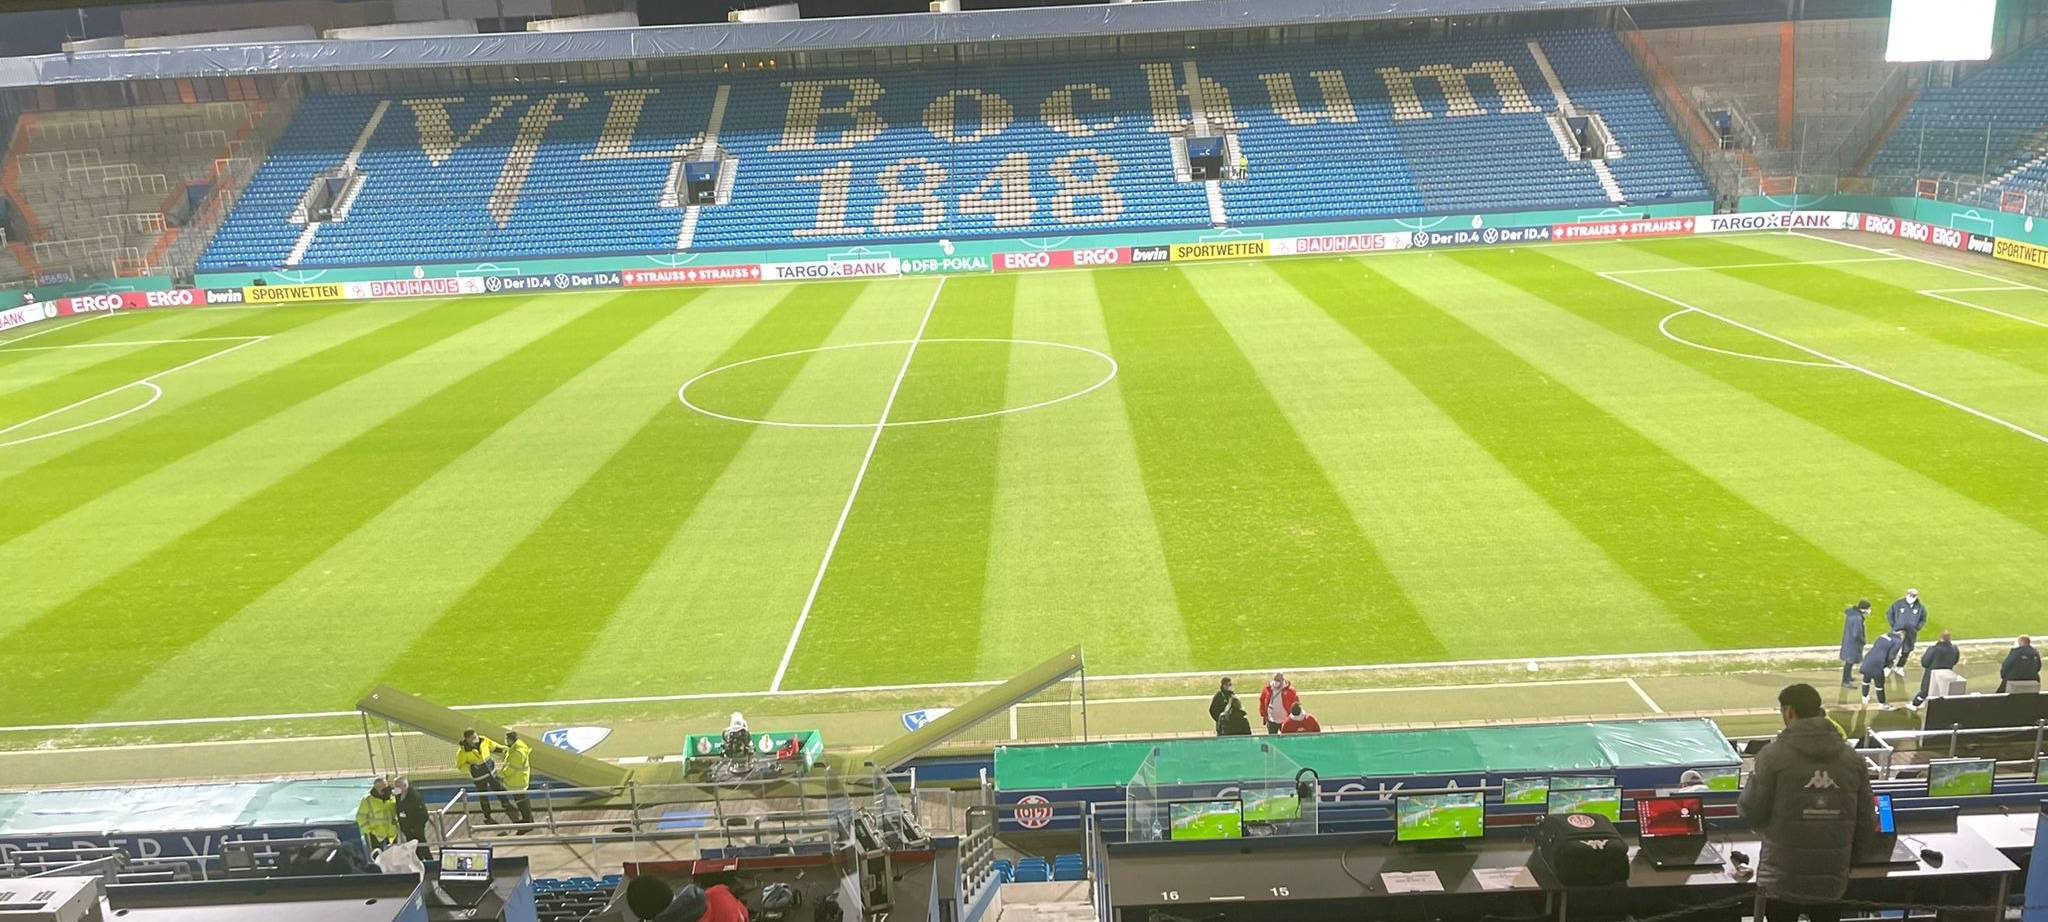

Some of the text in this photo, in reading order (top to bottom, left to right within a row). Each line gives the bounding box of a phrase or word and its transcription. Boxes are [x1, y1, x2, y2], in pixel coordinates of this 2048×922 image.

[402, 61, 1542, 231] VfL Bochum
[793, 148, 1125, 238] 1848
[1432, 233, 1452, 245] Der
[1455, 231, 1480, 244] ID.4
[1501, 229, 1522, 241] Der
[1524, 227, 1549, 240] ID.4
[1565, 219, 1682, 237] STRAUSS STRAUSS
[1865, 216, 1961, 249] ERGO ERGO ERGO
[1132, 242, 1264, 262] bwin SPORTWETTEN
[1296, 234, 1385, 253] BAUHAUS
[1968, 235, 1993, 255] bwin
[912, 256, 988, 272] DFB-POKAL
[1004, 248, 1118, 269] ERGO ERGO
[503, 278, 525, 289] Der
[527, 276, 551, 289] ID.4
[572, 275, 593, 286] Der
[595, 273, 620, 285] ID.4
[636, 267, 749, 283] STRAUSS STRAUSS
[207, 285, 338, 304] bwin SPORTWETTEN
[371, 278, 460, 297] BAUHAUS
[71, 289, 193, 313] ERGO ERGO
[1161, 890, 1179, 901] 16
[1270, 886, 1290, 897] 15
[872, 912, 888, 922] 17
